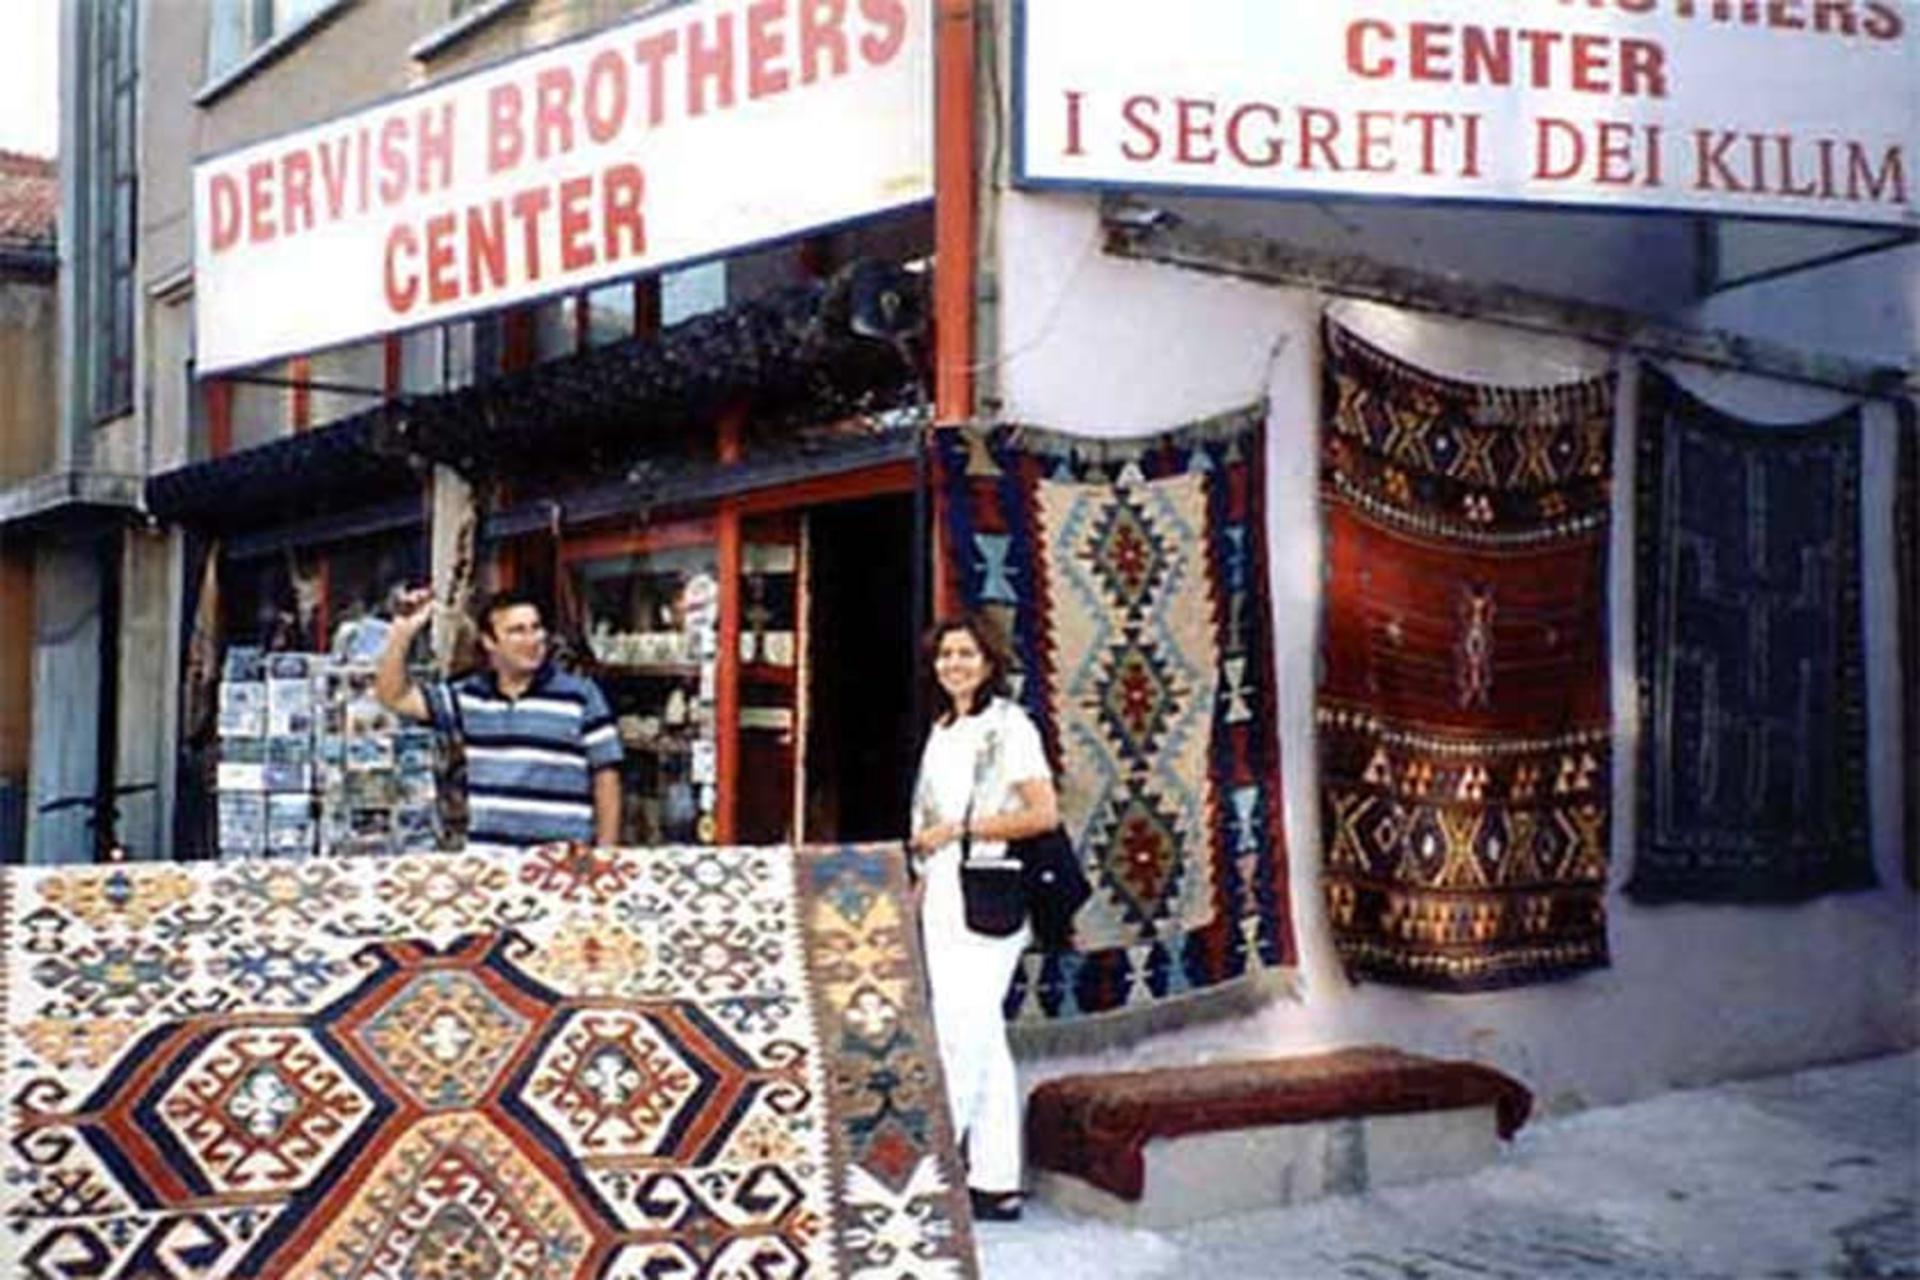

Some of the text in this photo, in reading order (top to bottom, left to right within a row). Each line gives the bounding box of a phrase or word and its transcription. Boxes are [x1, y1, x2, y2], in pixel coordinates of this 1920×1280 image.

[1346, 18, 1667, 97] CENTER
[209, 0, 906, 253] DERVISH BROTHERS
[1063, 91, 1908, 204] I SEGRETI DEI KILIM
[383, 163, 646, 314] CENTER
